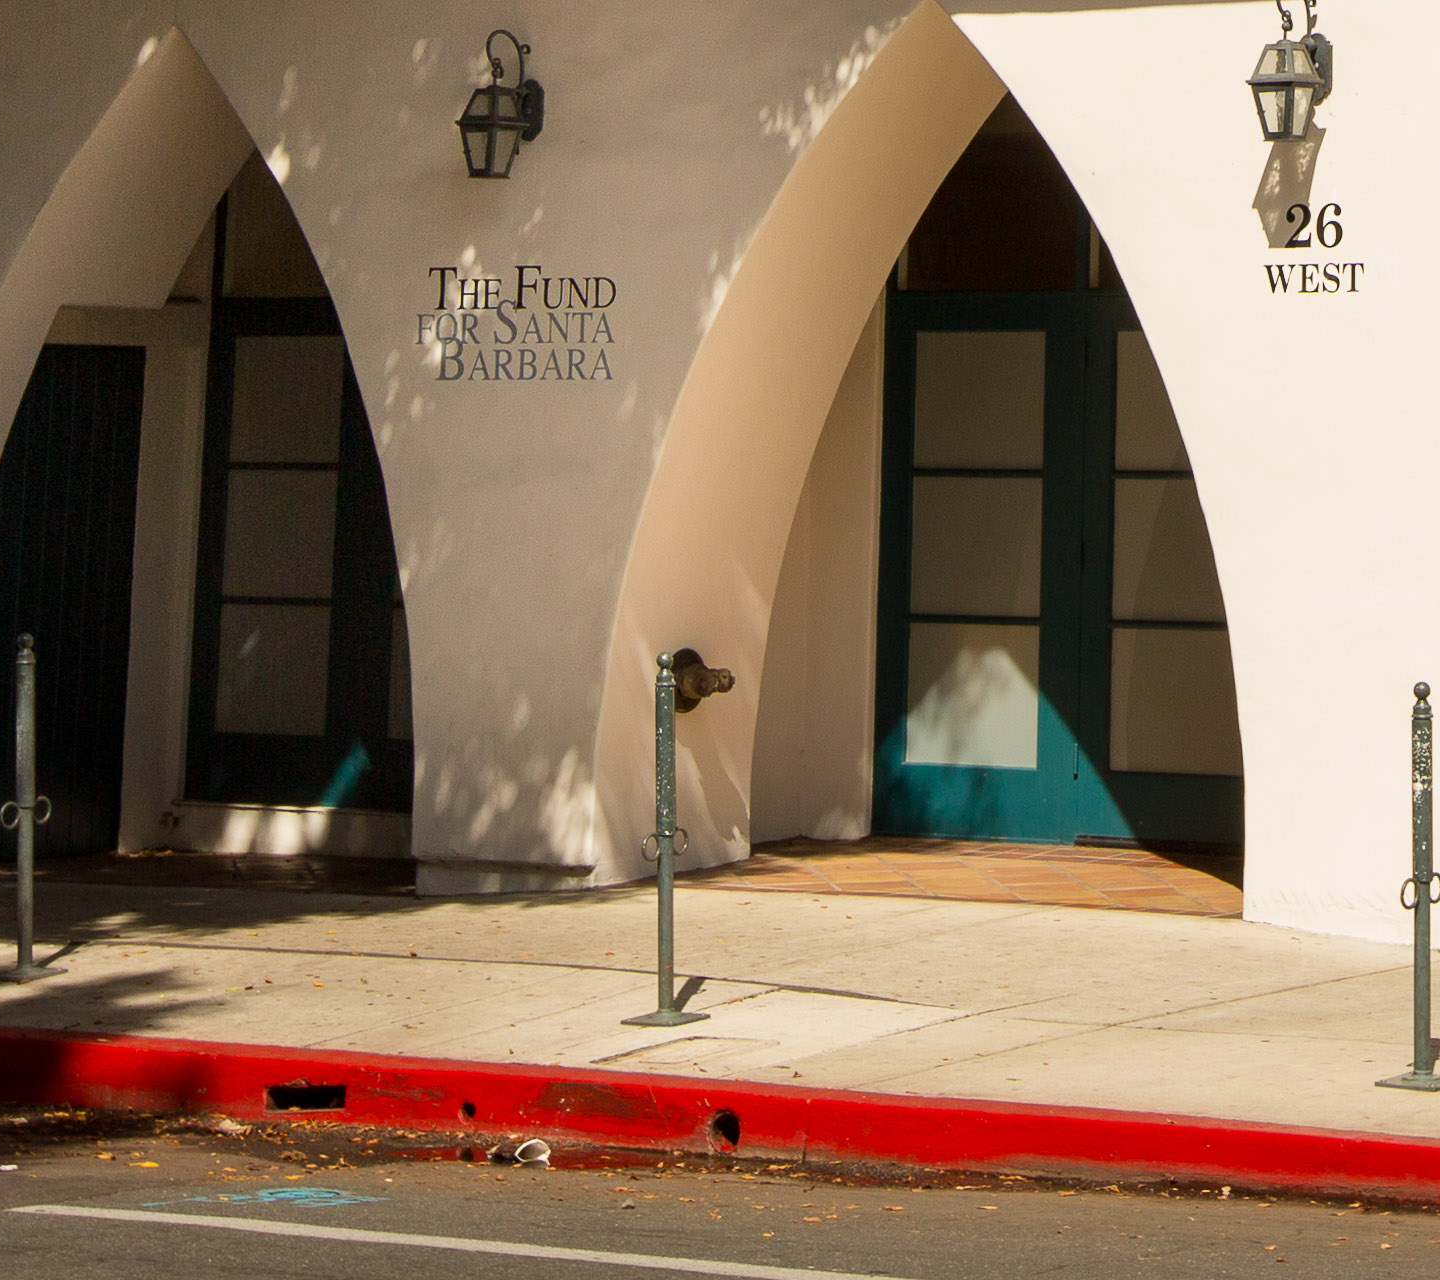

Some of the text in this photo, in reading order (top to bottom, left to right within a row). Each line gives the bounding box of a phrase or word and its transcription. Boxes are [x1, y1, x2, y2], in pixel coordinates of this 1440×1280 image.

[1284, 203, 1343, 248] 26
[1264, 262, 1365, 293] WEST
[415, 313, 480, 344] FOR
